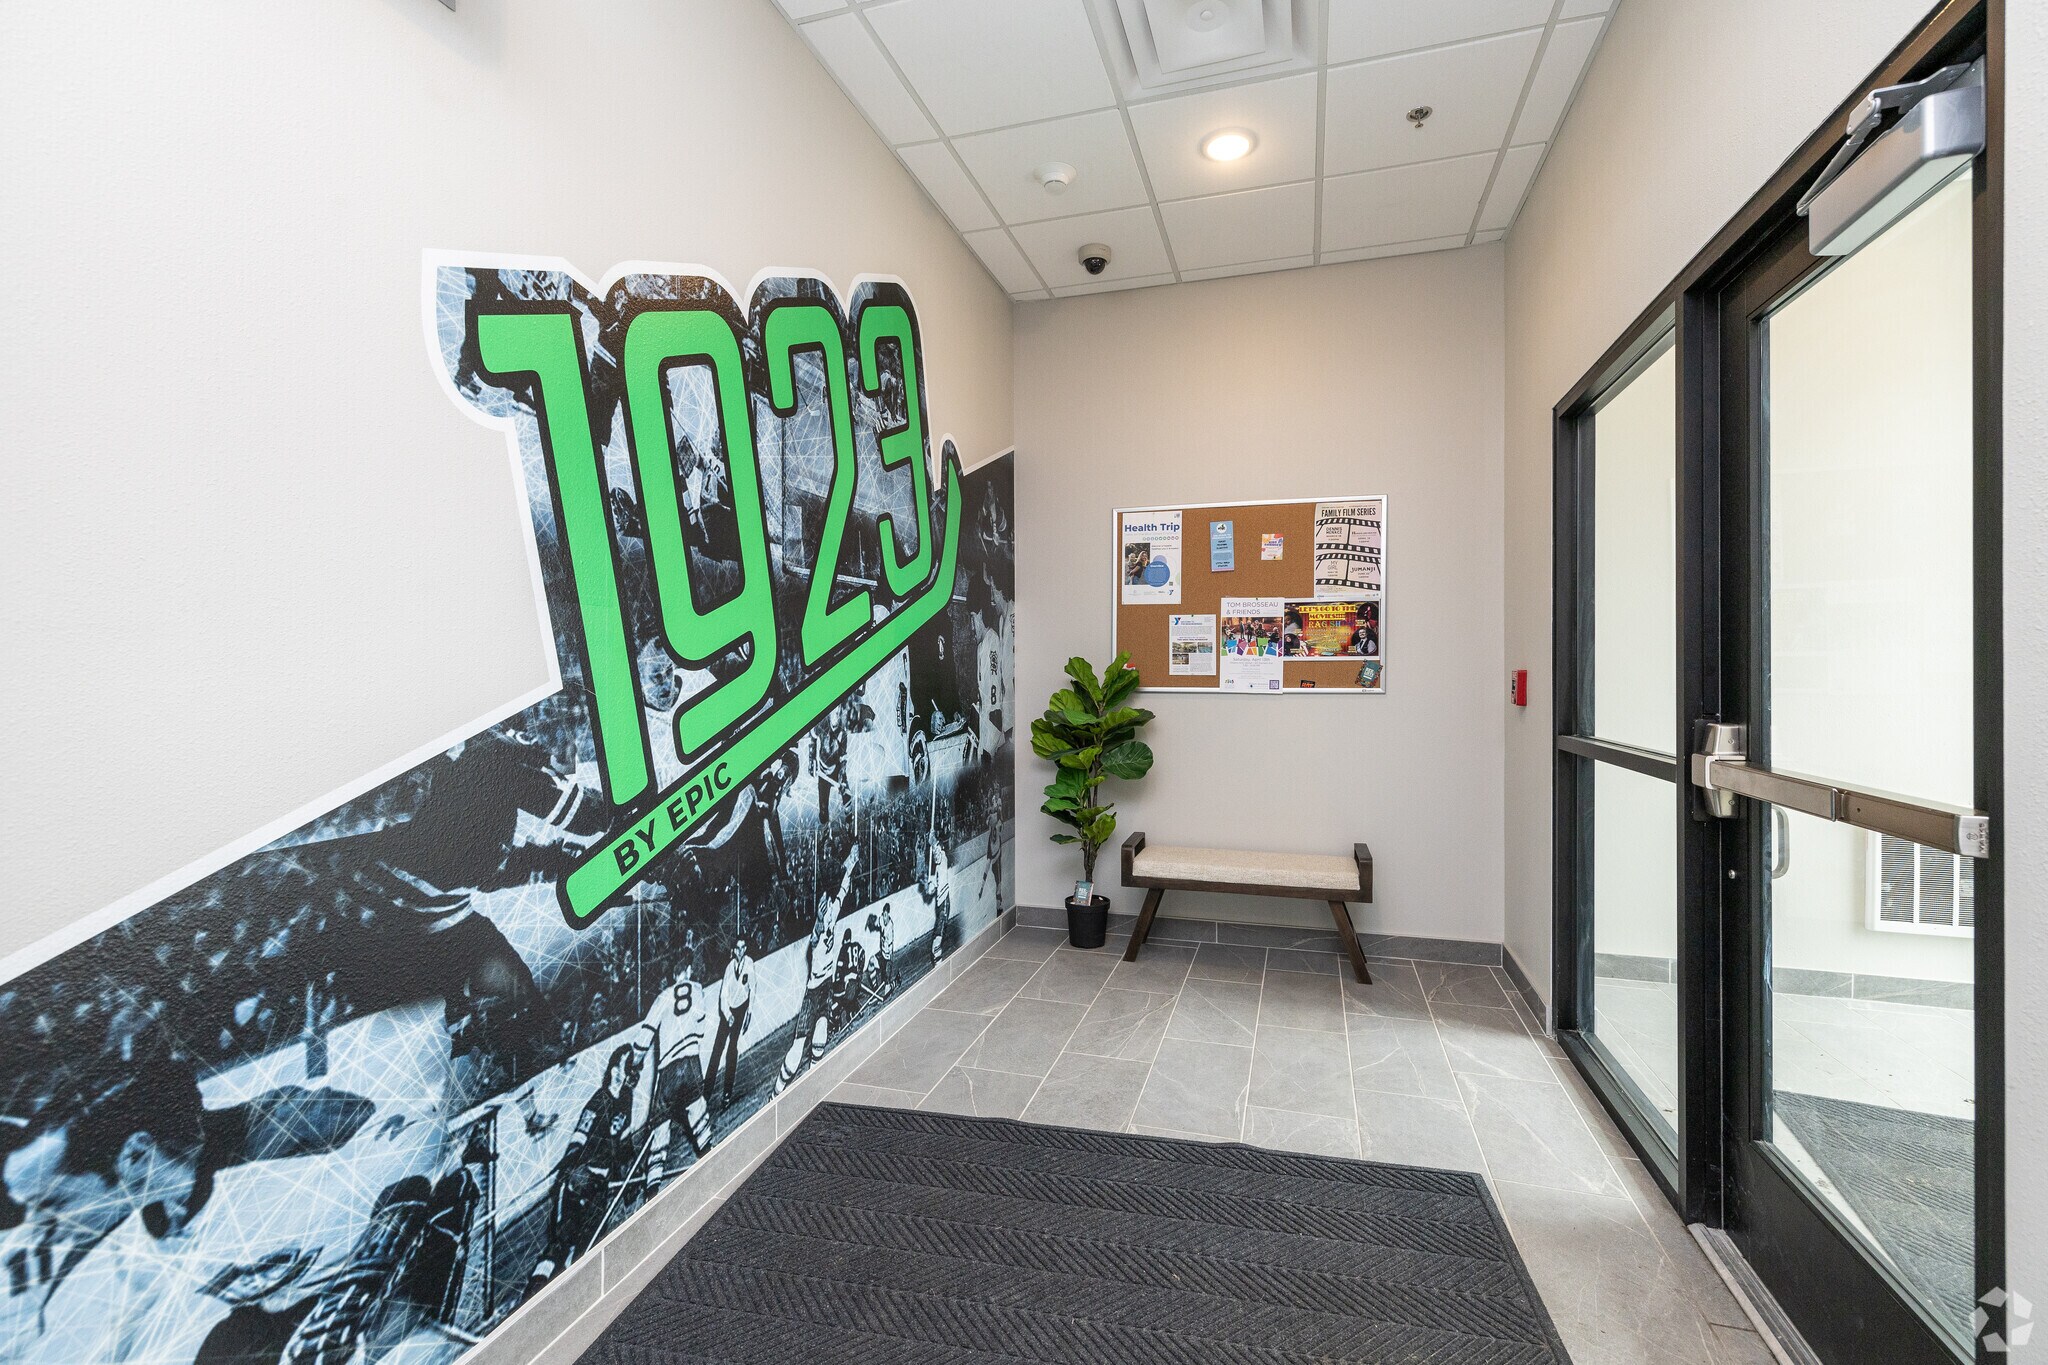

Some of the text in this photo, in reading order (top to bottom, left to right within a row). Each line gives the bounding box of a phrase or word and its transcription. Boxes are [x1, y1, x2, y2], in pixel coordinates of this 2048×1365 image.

[1321, 507, 1376, 517] FAMILY FILM SERIES
[1124, 522, 1180, 532] Health Trip
[477, 304, 932, 806] 1923
[613, 762, 732, 877] BY EPIC
[846, 945, 859, 969] 18
[673, 982, 693, 1017] 8
